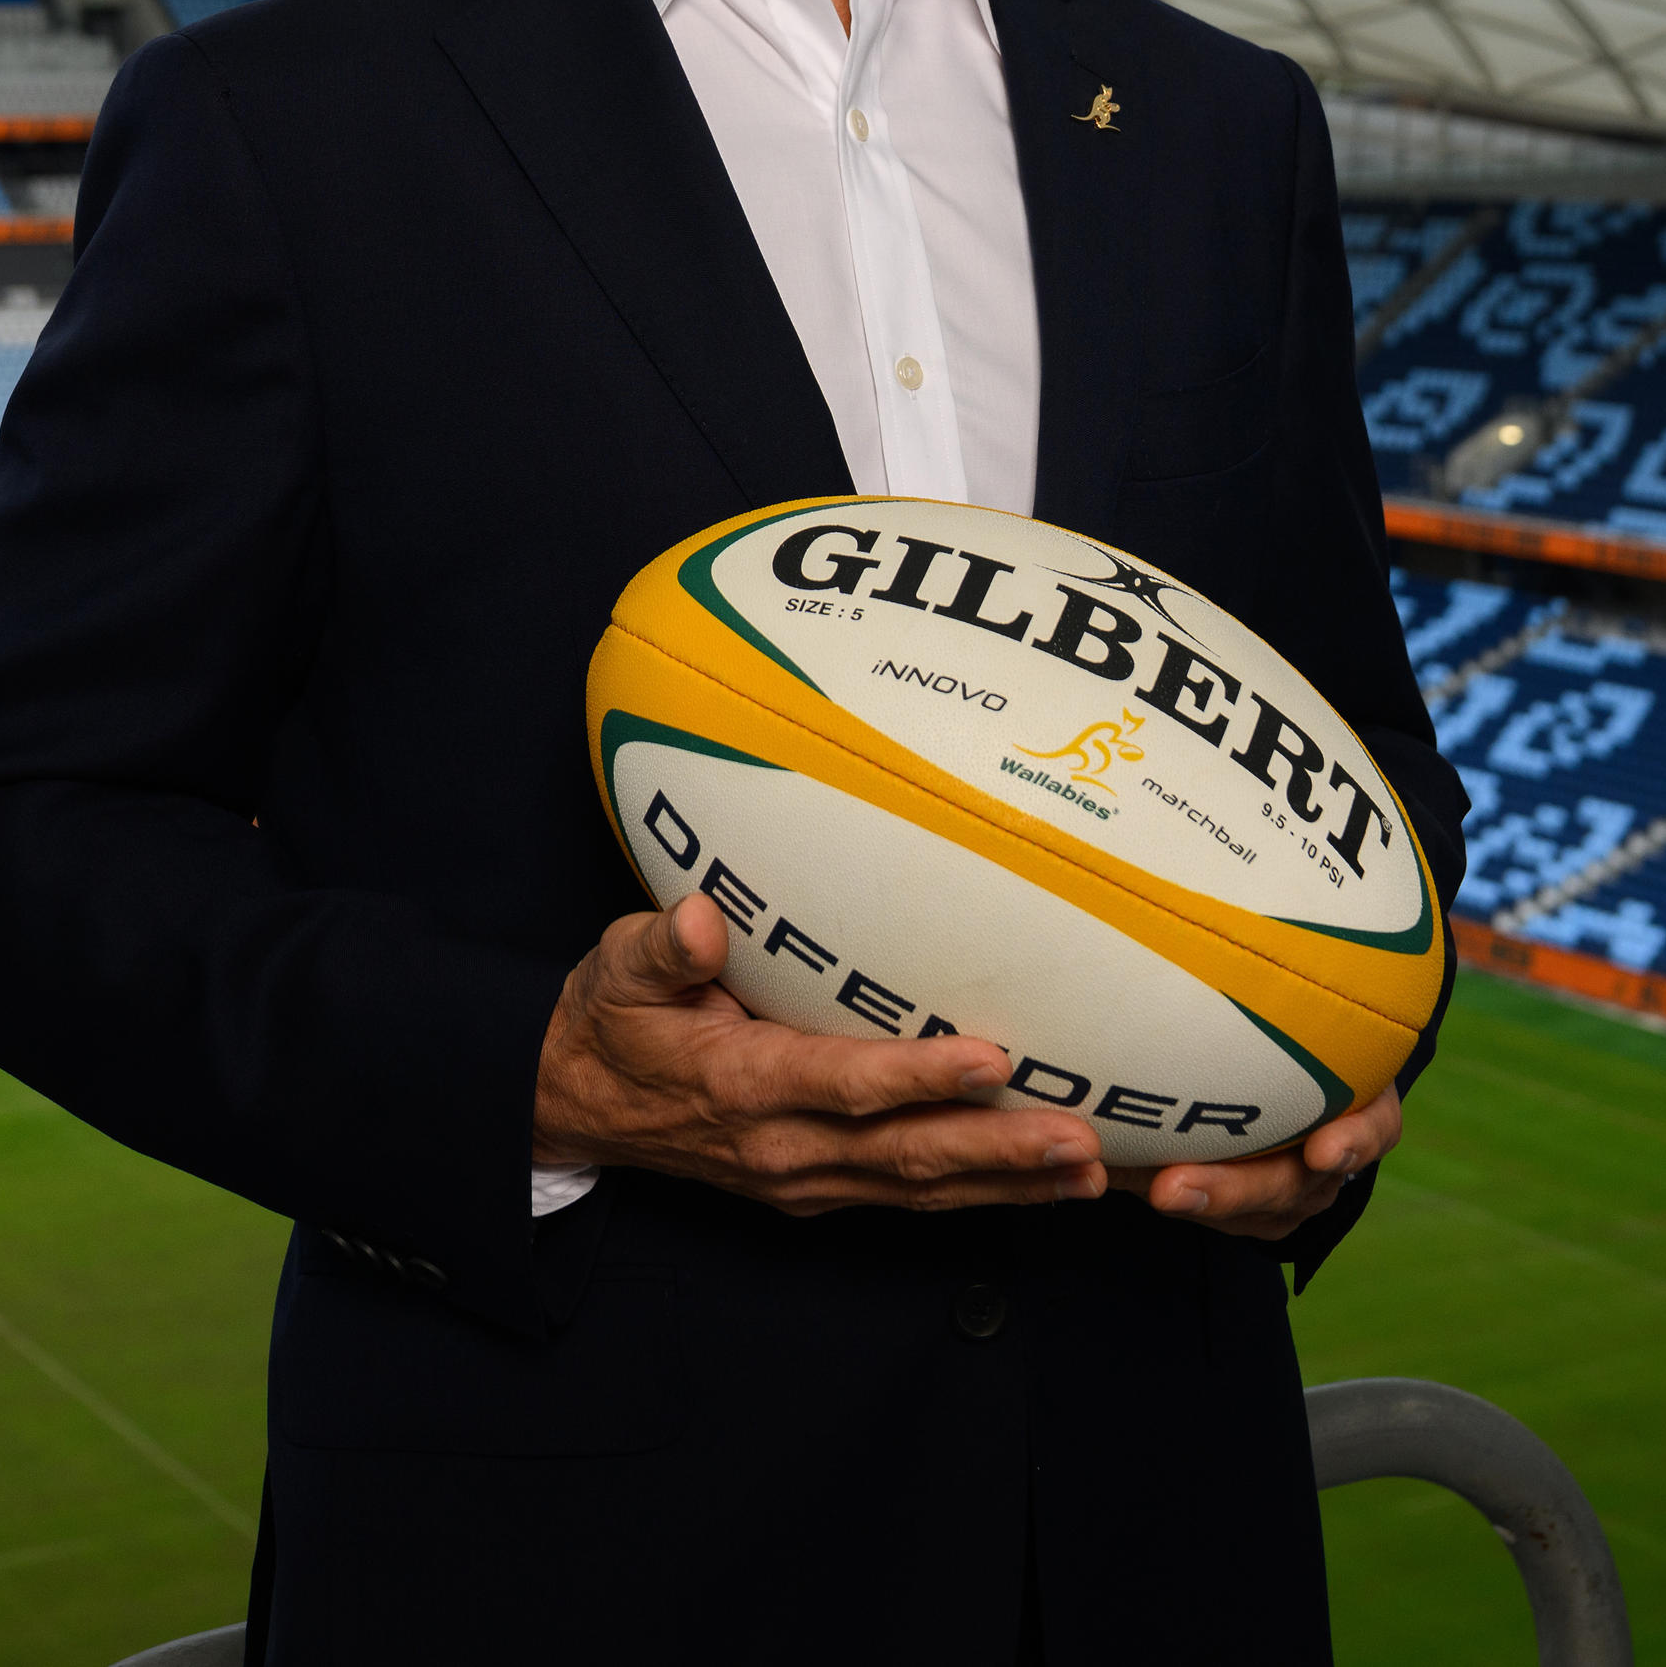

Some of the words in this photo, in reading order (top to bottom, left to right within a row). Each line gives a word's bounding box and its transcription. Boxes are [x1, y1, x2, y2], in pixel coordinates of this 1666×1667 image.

[785, 597, 834, 617] SIZE
[850, 607, 865, 622] 5
[771, 524, 1392, 880] GILBERT
[999, 756, 1112, 821] Wallabies
[1141, 777, 1258, 865] matchball
[1261, 802, 1288, 830] 9.5
[1300, 836, 1318, 860] 10
[1319, 854, 1345, 889] PSI
